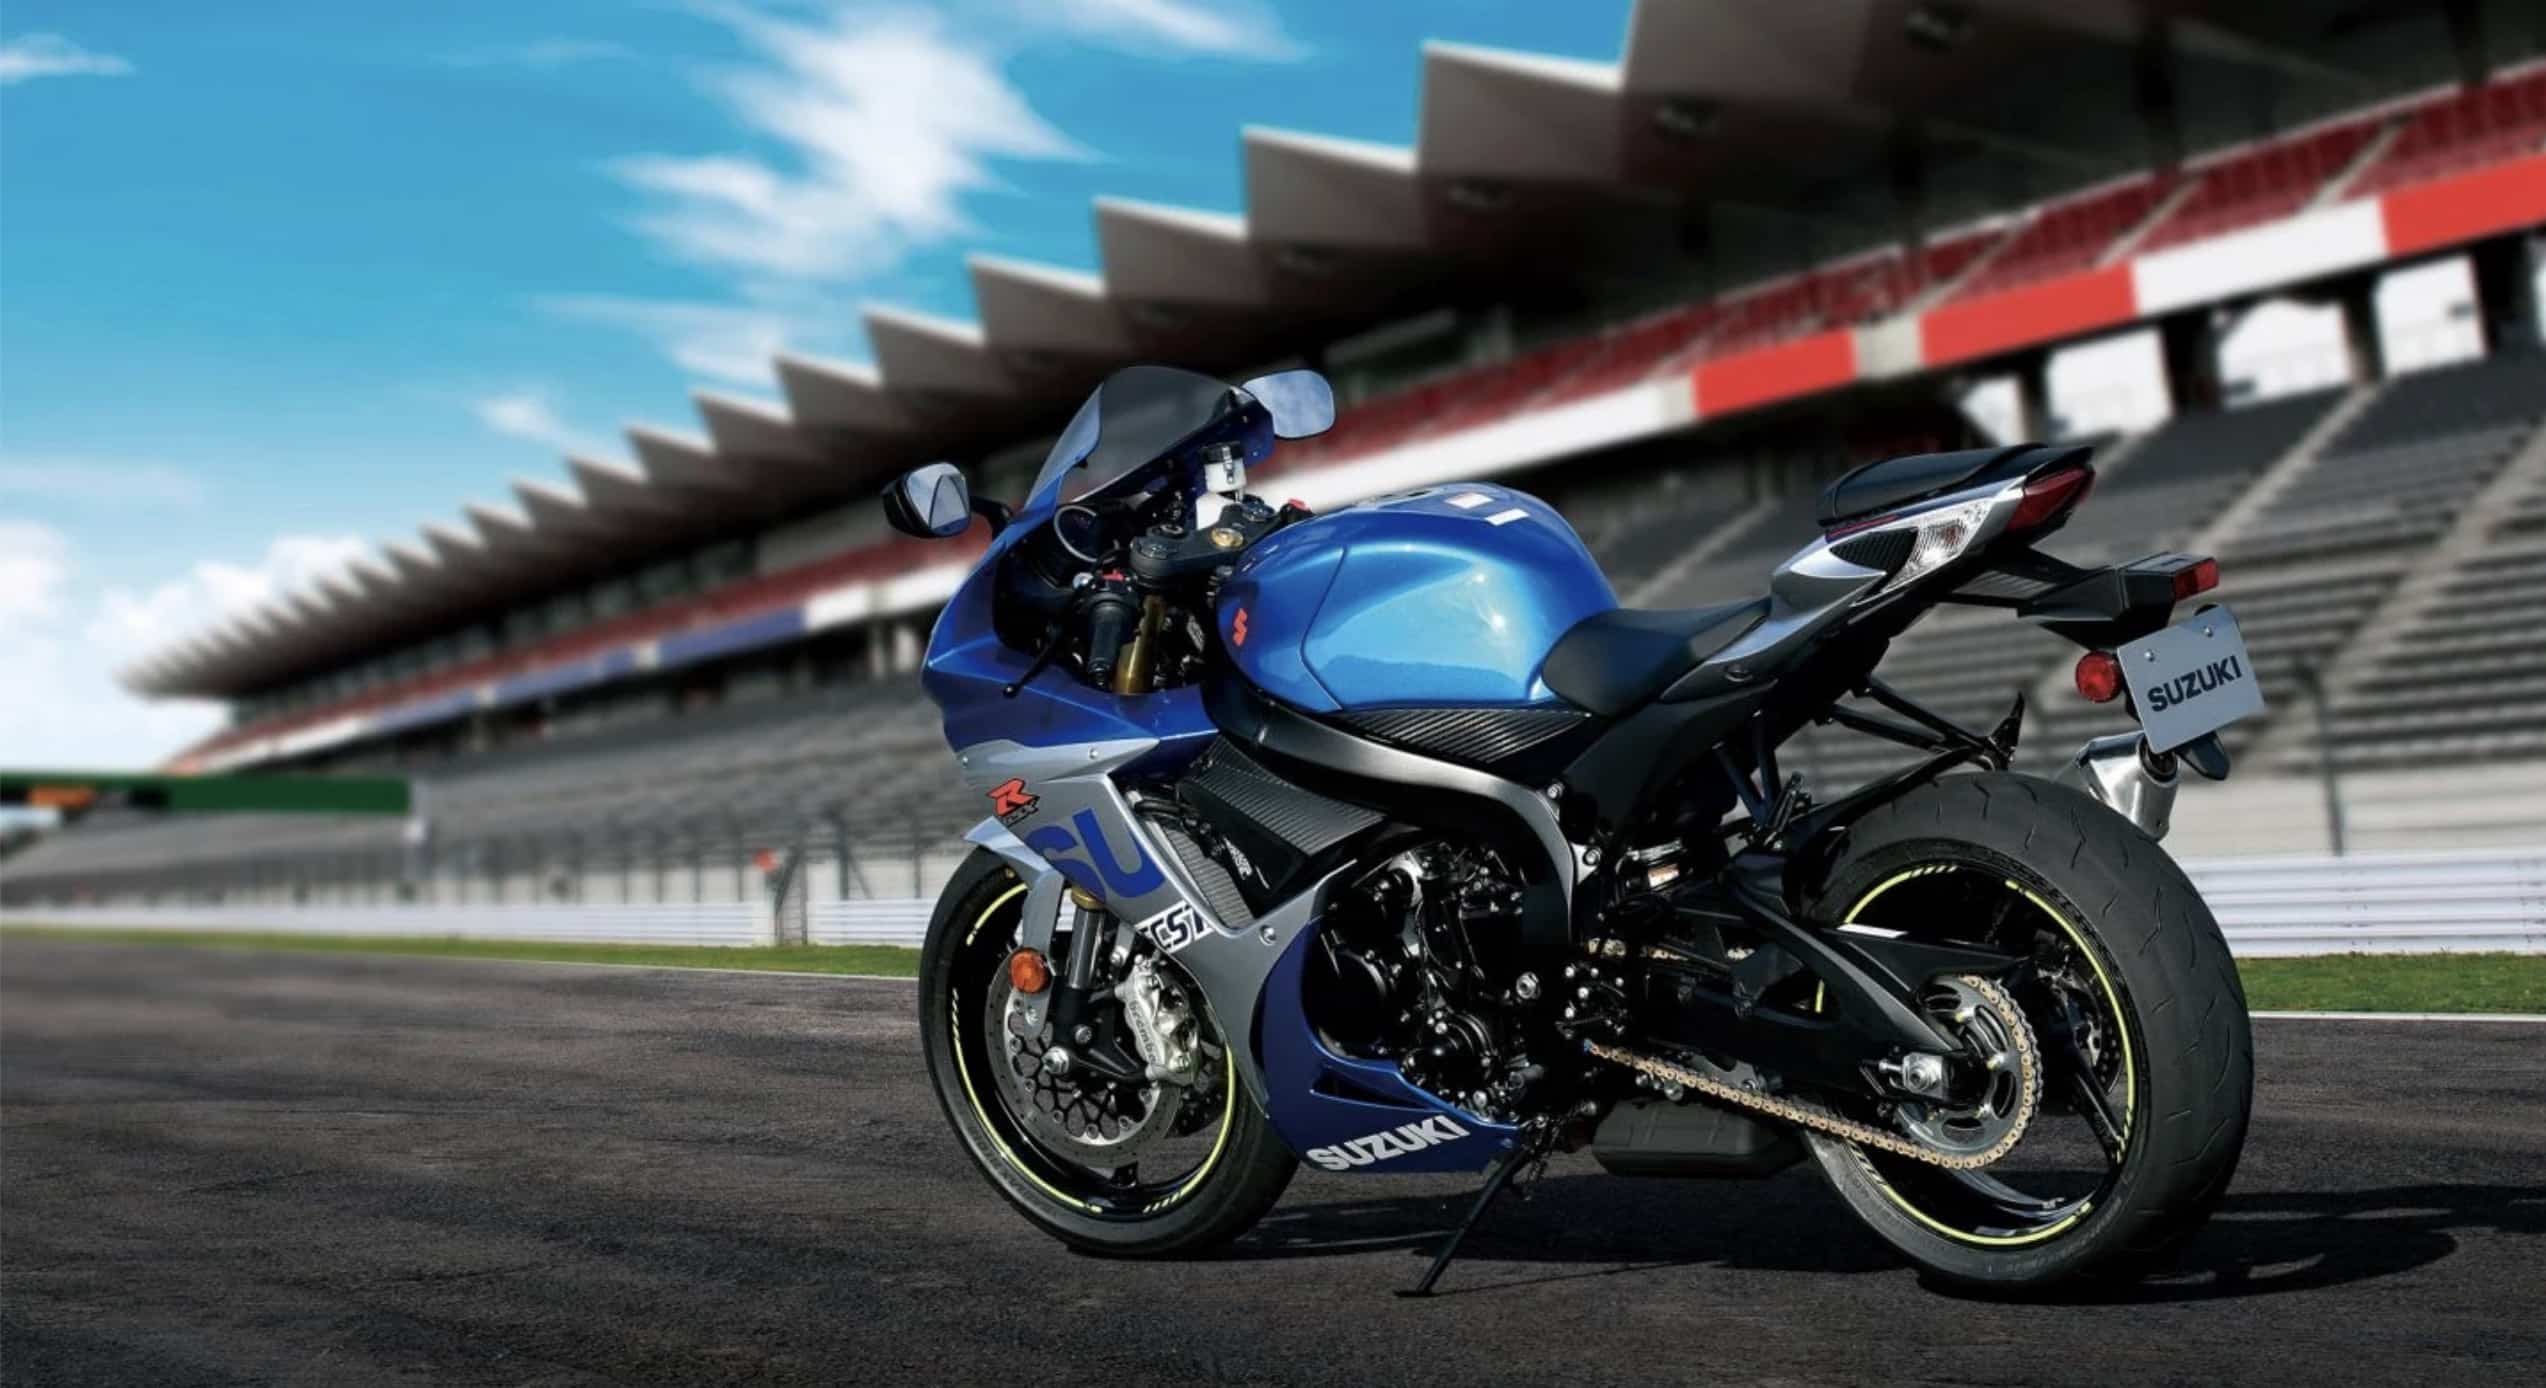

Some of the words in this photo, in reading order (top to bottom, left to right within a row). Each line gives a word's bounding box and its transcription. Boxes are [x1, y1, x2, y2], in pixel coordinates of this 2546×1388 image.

[2147, 655, 2243, 712] SUZUKI
[1024, 808, 1166, 902] SU
[1306, 1115, 1471, 1171] SUZUKI
